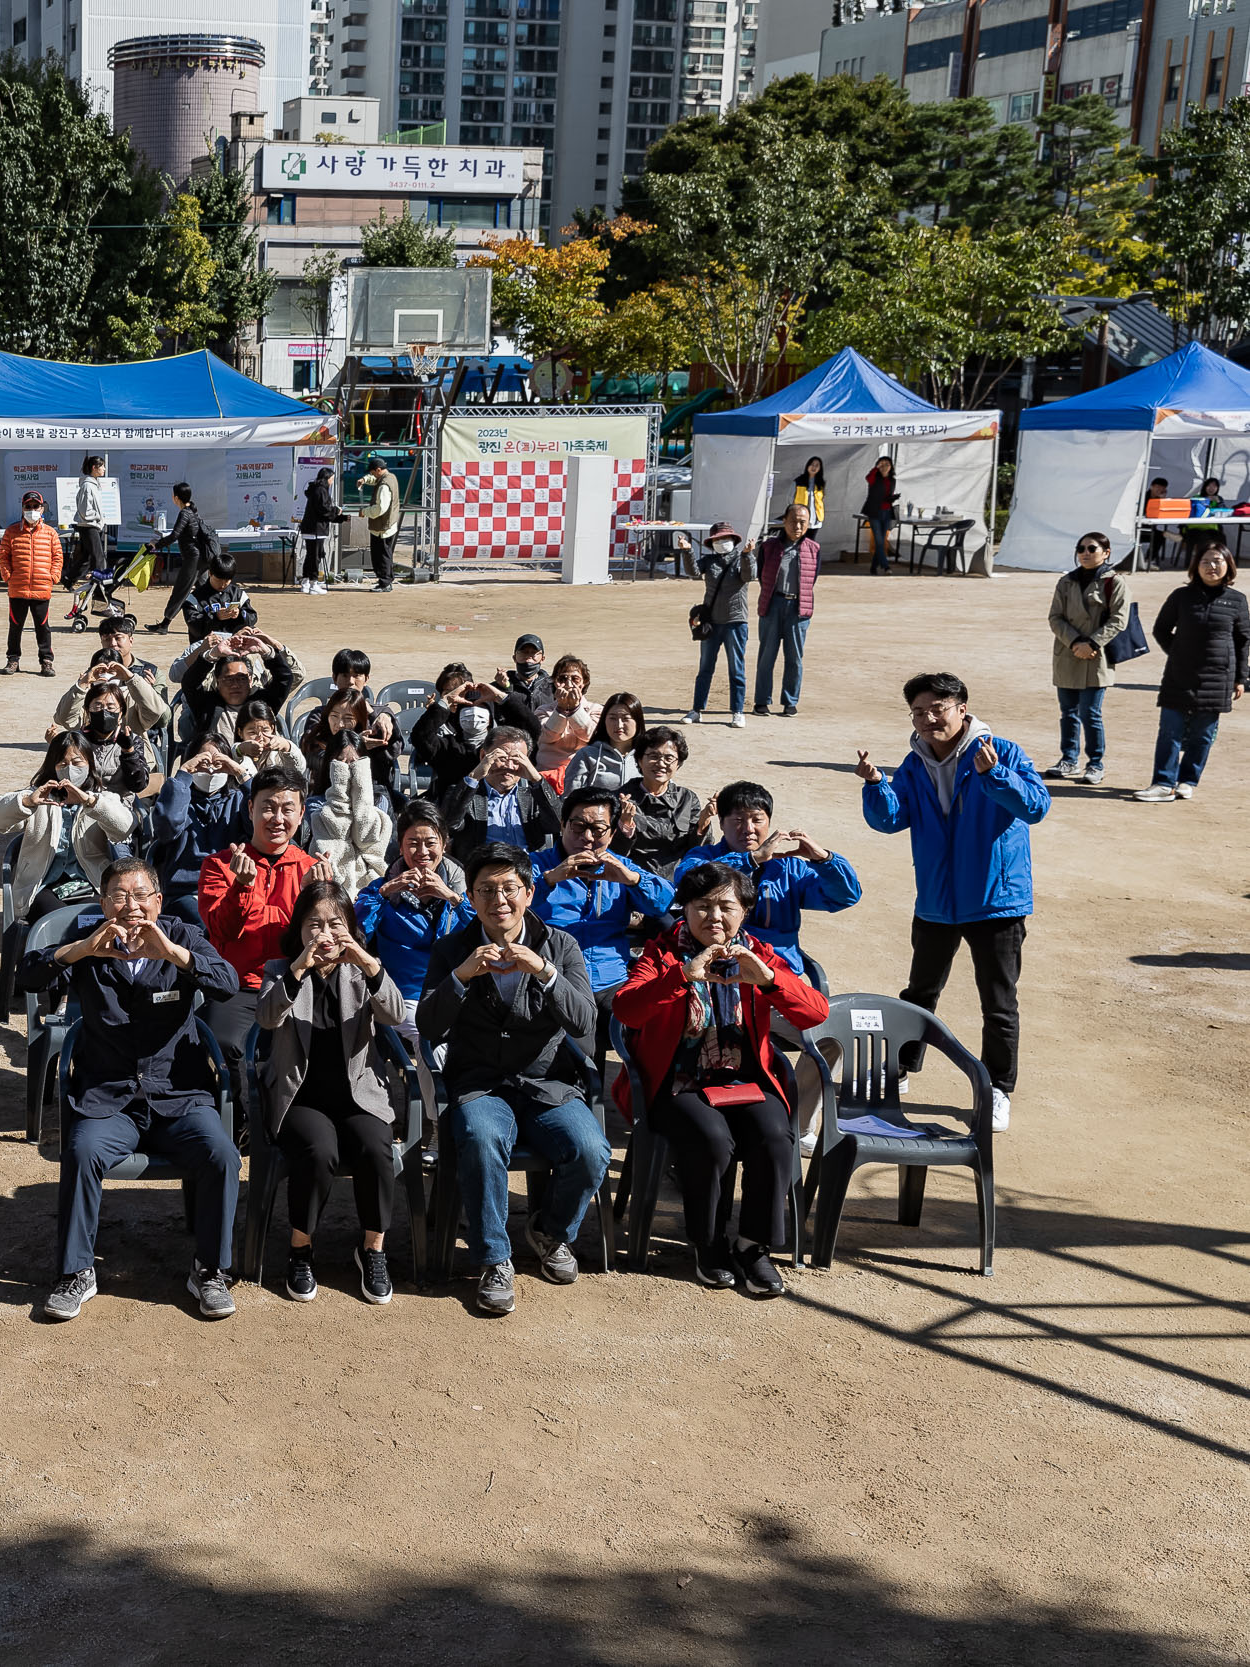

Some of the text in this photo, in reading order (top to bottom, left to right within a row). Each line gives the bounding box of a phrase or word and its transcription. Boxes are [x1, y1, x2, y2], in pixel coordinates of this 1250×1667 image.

[316, 153, 506, 180] 사랑 가득한 치과
[15, 427, 45, 439] 행복할
[48, 427, 78, 439] 광진구
[81, 427, 121, 439] 청소년과
[124, 427, 174, 439] 함께합니다
[477, 428, 508, 437] 2023년
[832, 426, 851, 437] 우리
[854, 425, 893, 437] 가족사진
[896, 425, 915, 436] 액자
[477, 441, 501, 453] 광진
[562, 440, 608, 452] 가족축제
